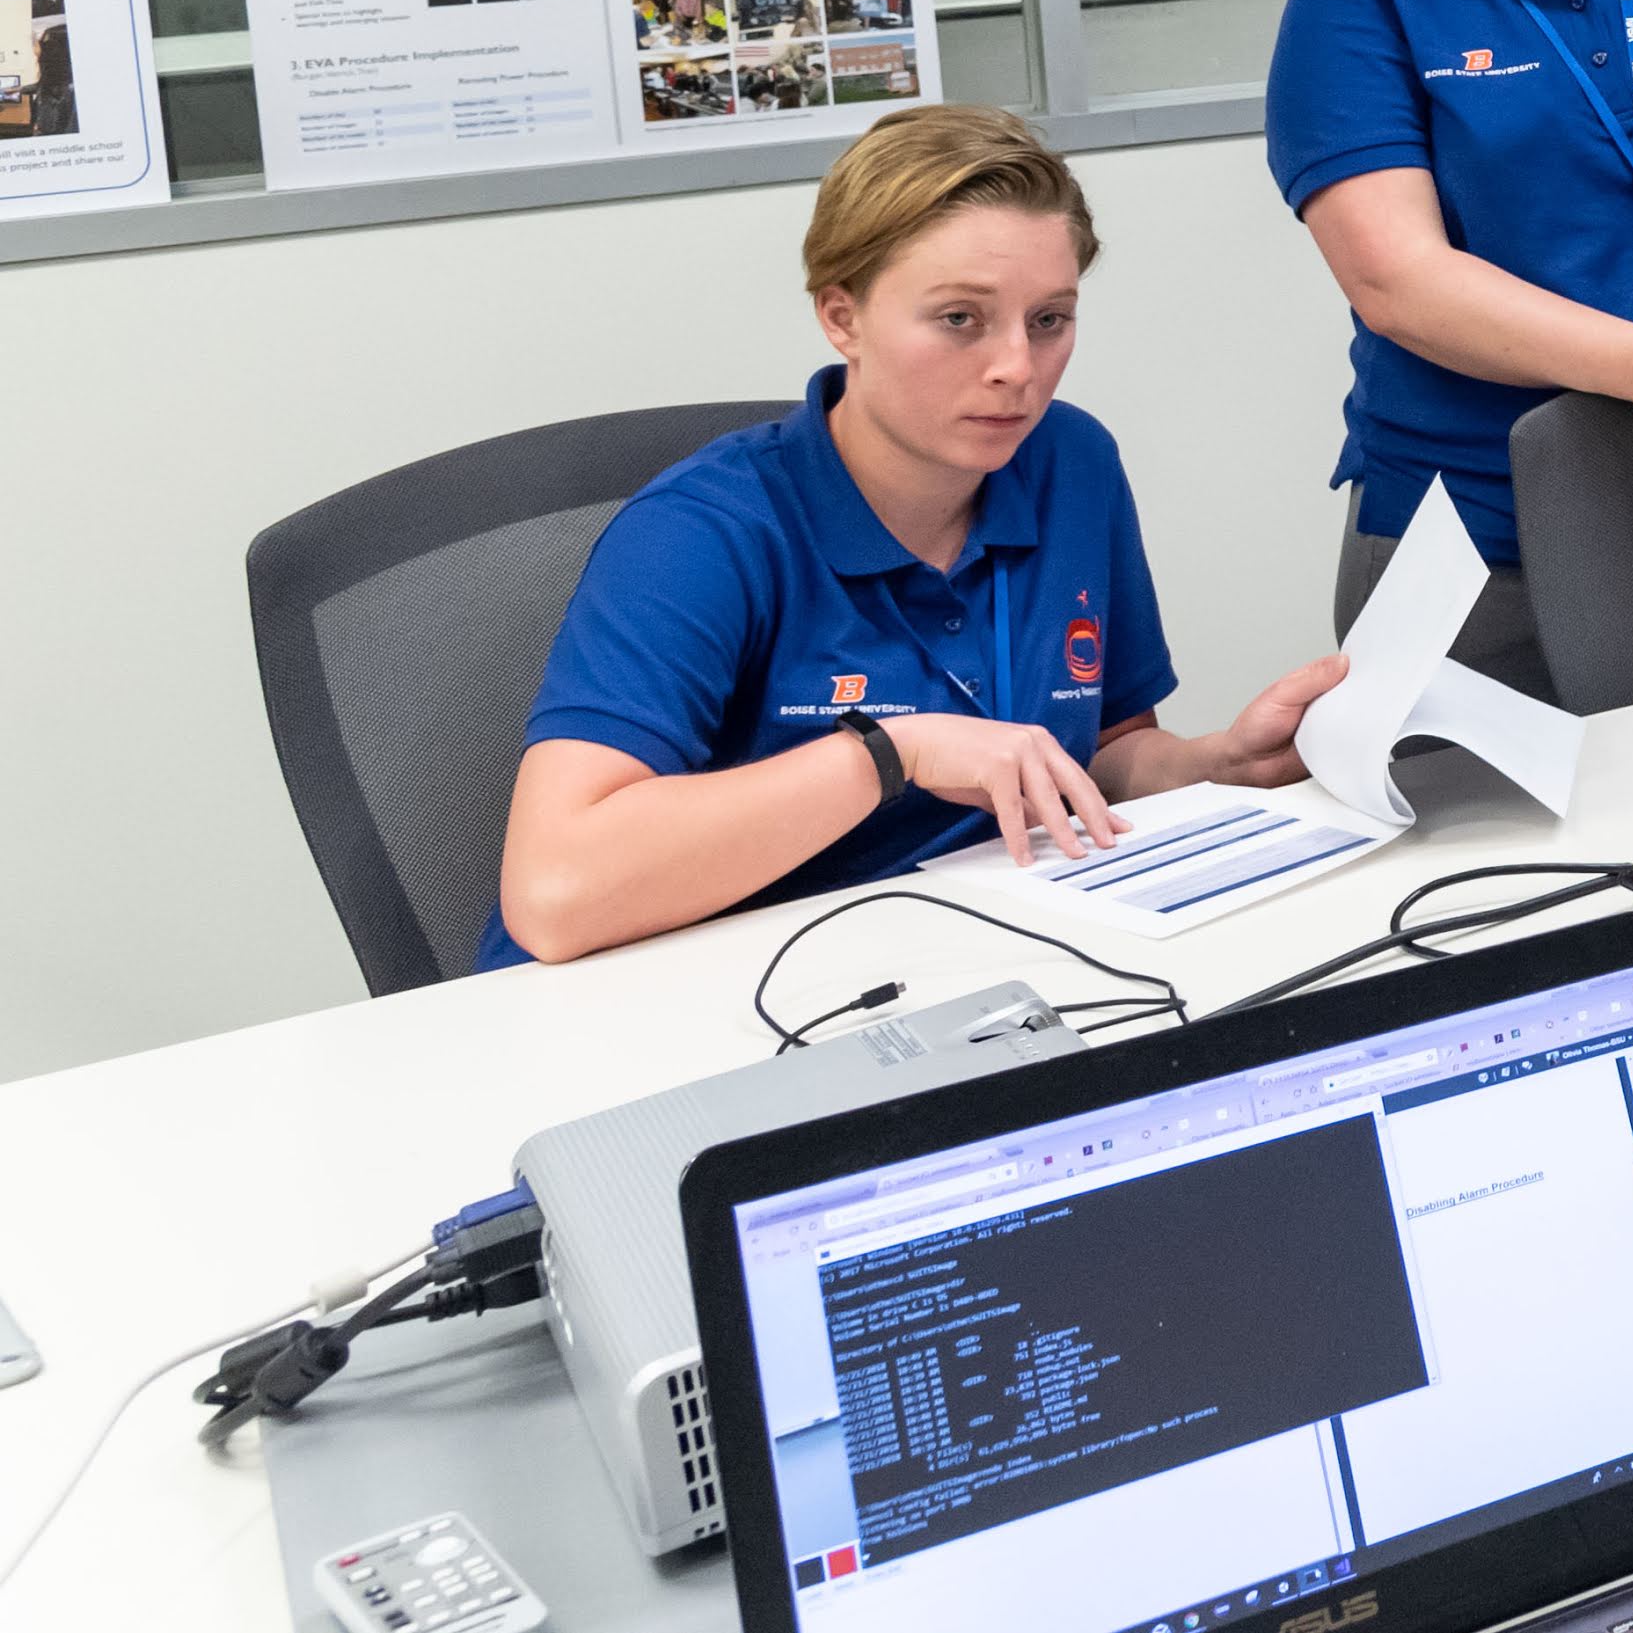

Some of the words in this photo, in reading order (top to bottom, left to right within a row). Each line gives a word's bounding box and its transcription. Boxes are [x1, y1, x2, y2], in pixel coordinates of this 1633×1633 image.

[305, 58, 335, 69] EVA
[339, 53, 409, 66] Procedure
[413, 44, 520, 61] Implementation
[1425, 69, 1453, 79] BOISE
[1455, 67, 1483, 78] STATE
[1484, 61, 1541, 76] UNIVERSITY
[49, 143, 86, 156] middle
[89, 140, 123, 152] school
[10, 159, 49, 175] project
[781, 705, 816, 716] BOISE
[818, 706, 851, 716] STATE
[1562, 1048, 1583, 1060] Olivia
[1582, 1036, 1627, 1054] Thomas-BSU
[1405, 1196, 1457, 1219] Disabling
[1458, 1187, 1490, 1203] Alarm
[1491, 1170, 1545, 1193] Procedure
[863, 1251, 909, 1271] Microsoft
[912, 1234, 973, 1258] Corporation.
[976, 1228, 992, 1240] All
[995, 1219, 1026, 1235] rights
[1029, 1206, 1073, 1225] reserved.
[835, 1341, 883, 1363] Directory
[1080, 1410, 1101, 1423] free
[1161, 1416, 1182, 1430] such
[1184, 1405, 1219, 1424] process
